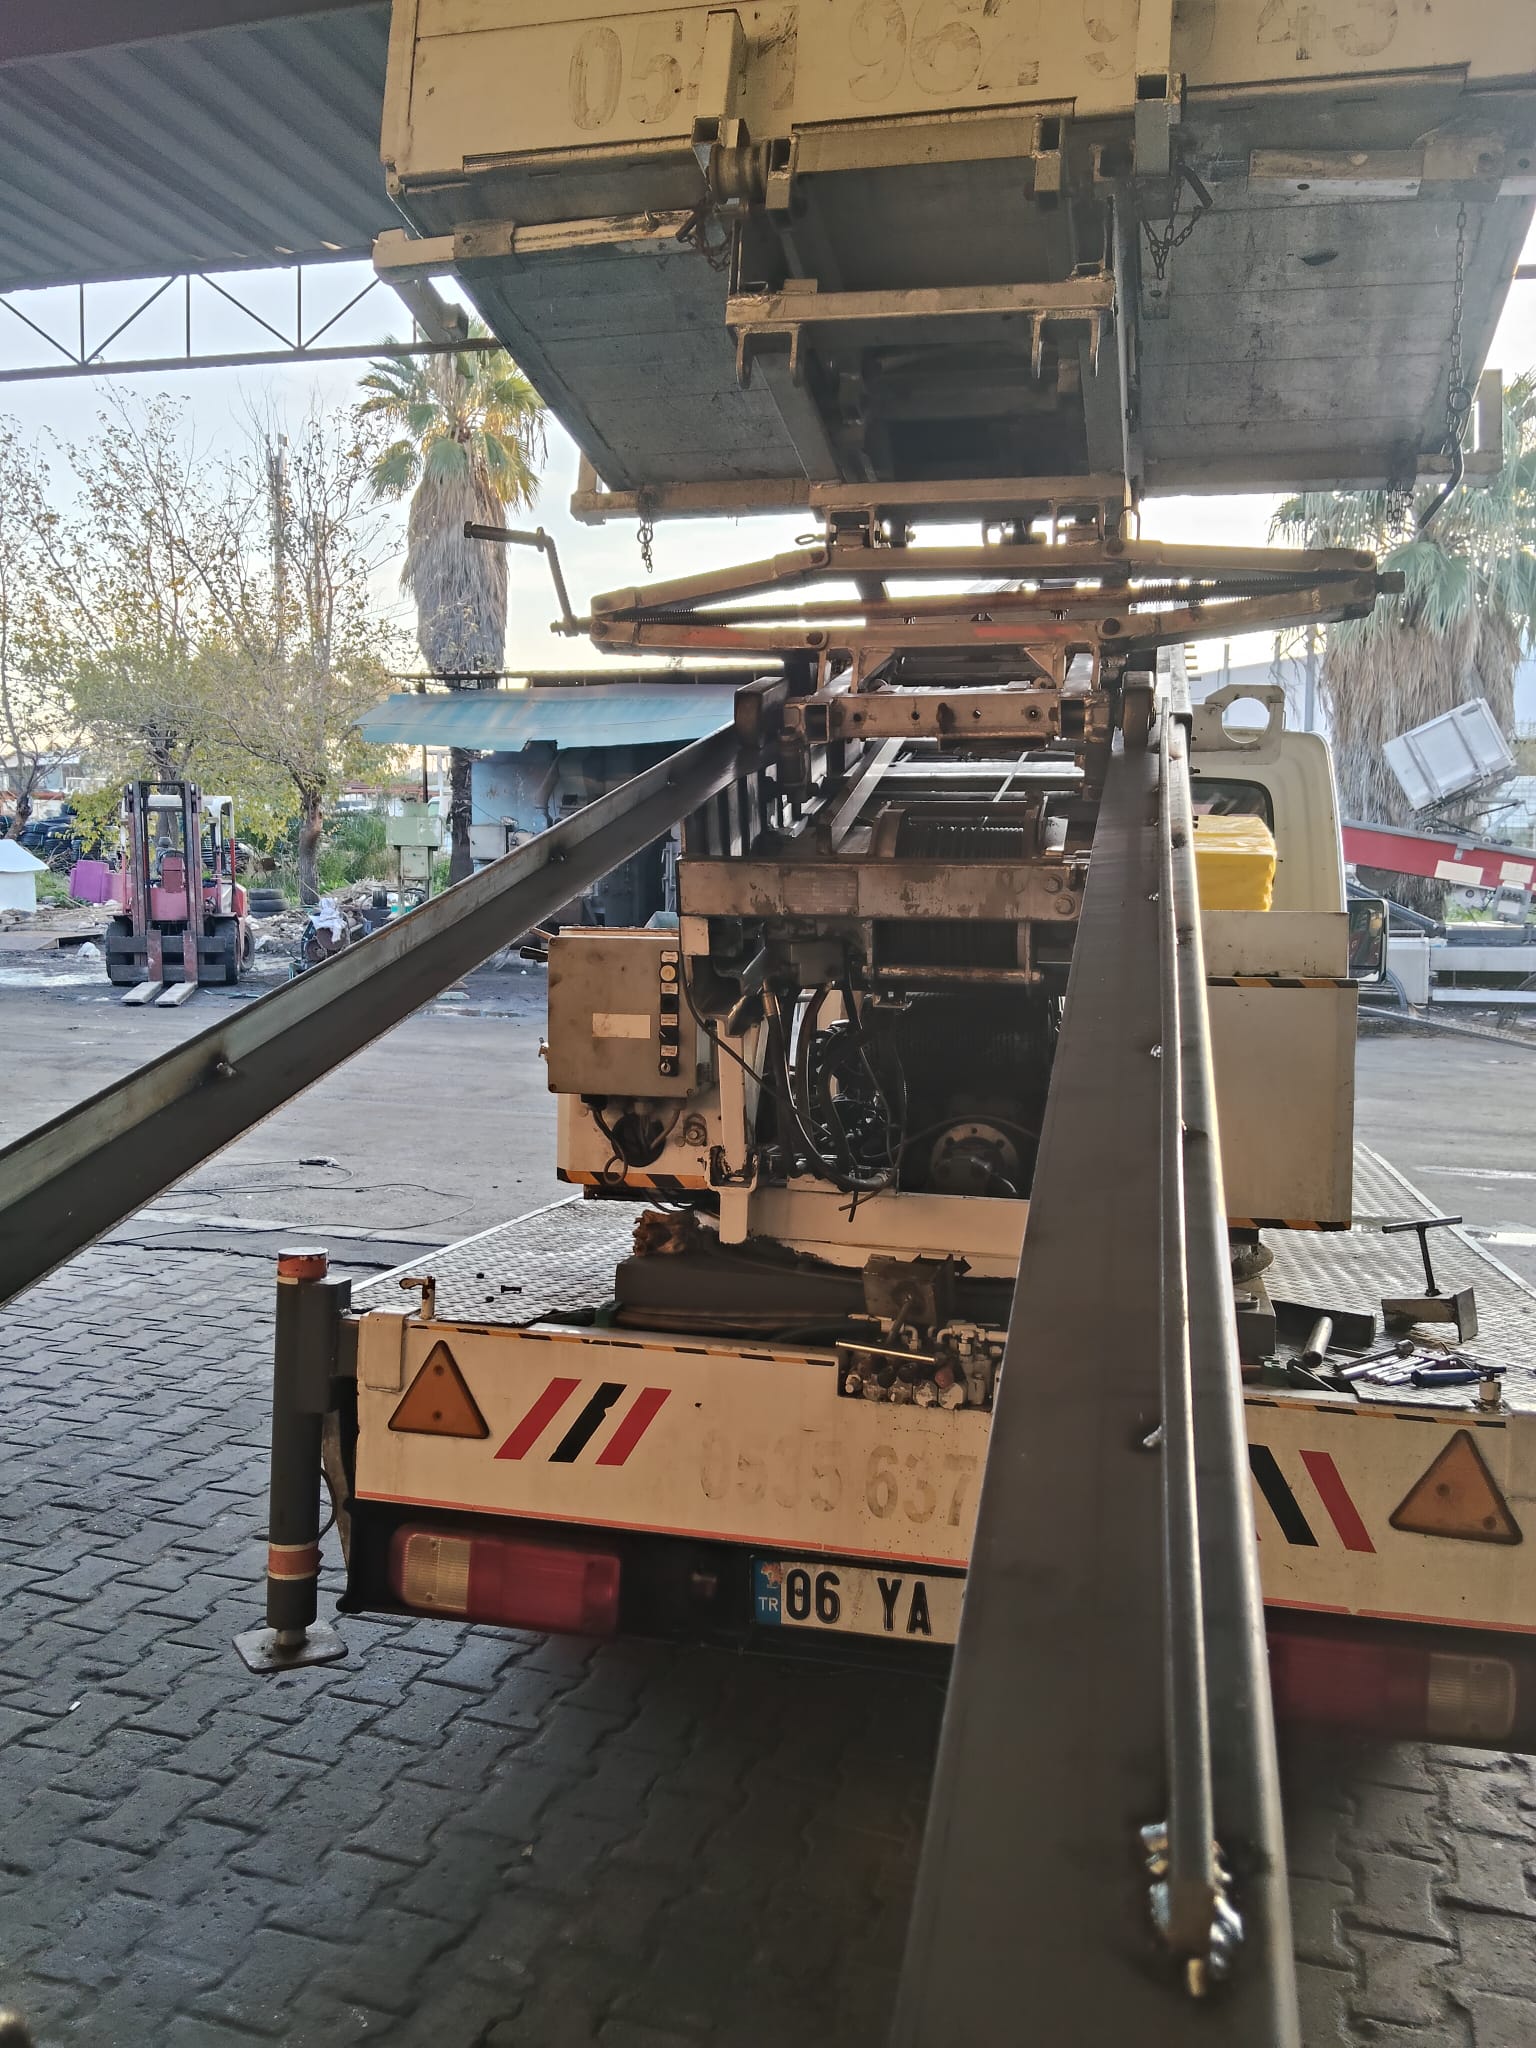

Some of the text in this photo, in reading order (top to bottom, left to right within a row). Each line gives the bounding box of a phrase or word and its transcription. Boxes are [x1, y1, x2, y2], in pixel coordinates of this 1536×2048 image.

[758, 1596, 779, 1612] TR
[786, 1568, 932, 1636] 06 YA
